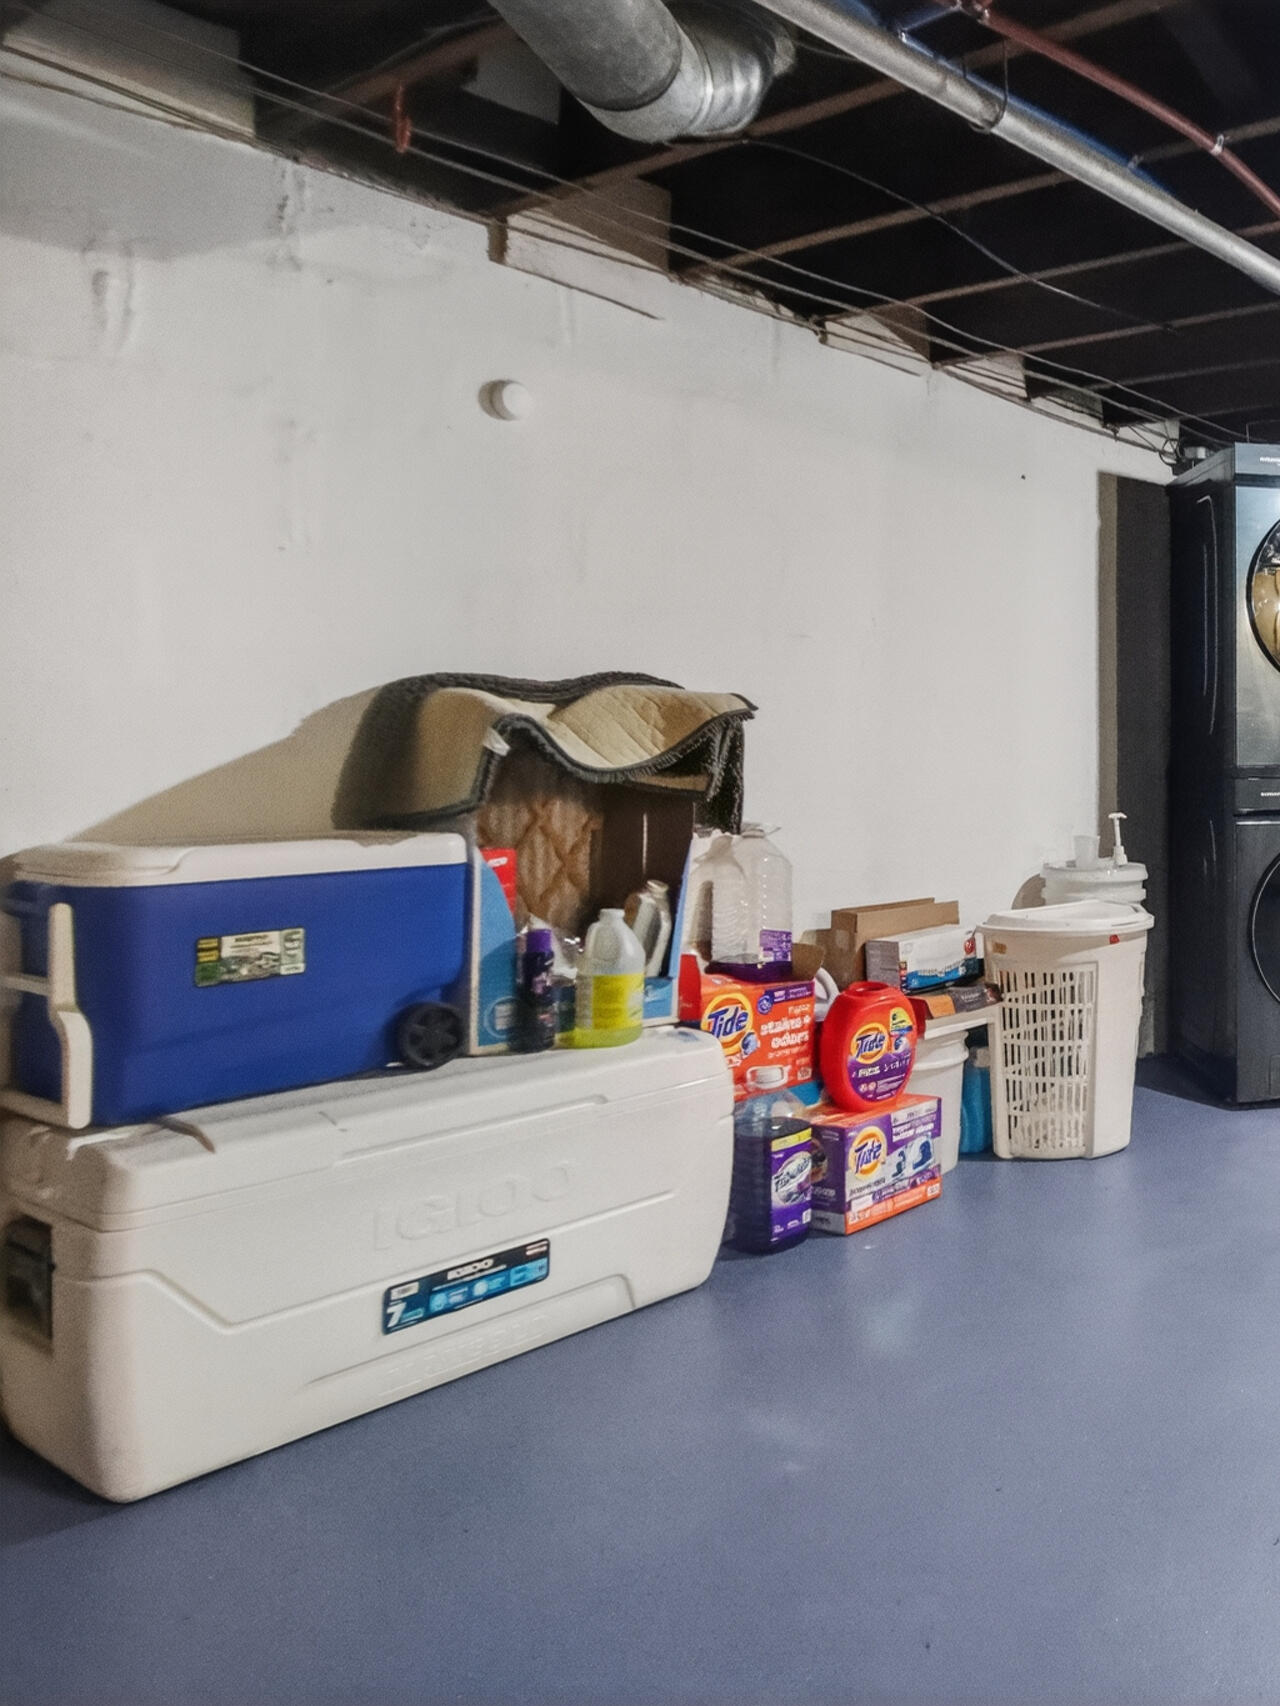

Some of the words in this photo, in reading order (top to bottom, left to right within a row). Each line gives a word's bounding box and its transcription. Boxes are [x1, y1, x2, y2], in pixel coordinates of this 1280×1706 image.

[708, 1006, 749, 1038] Tide
[855, 1031, 886, 1059] Tide
[854, 1138, 882, 1174] Tide
[386, 1302, 406, 1328] 7
